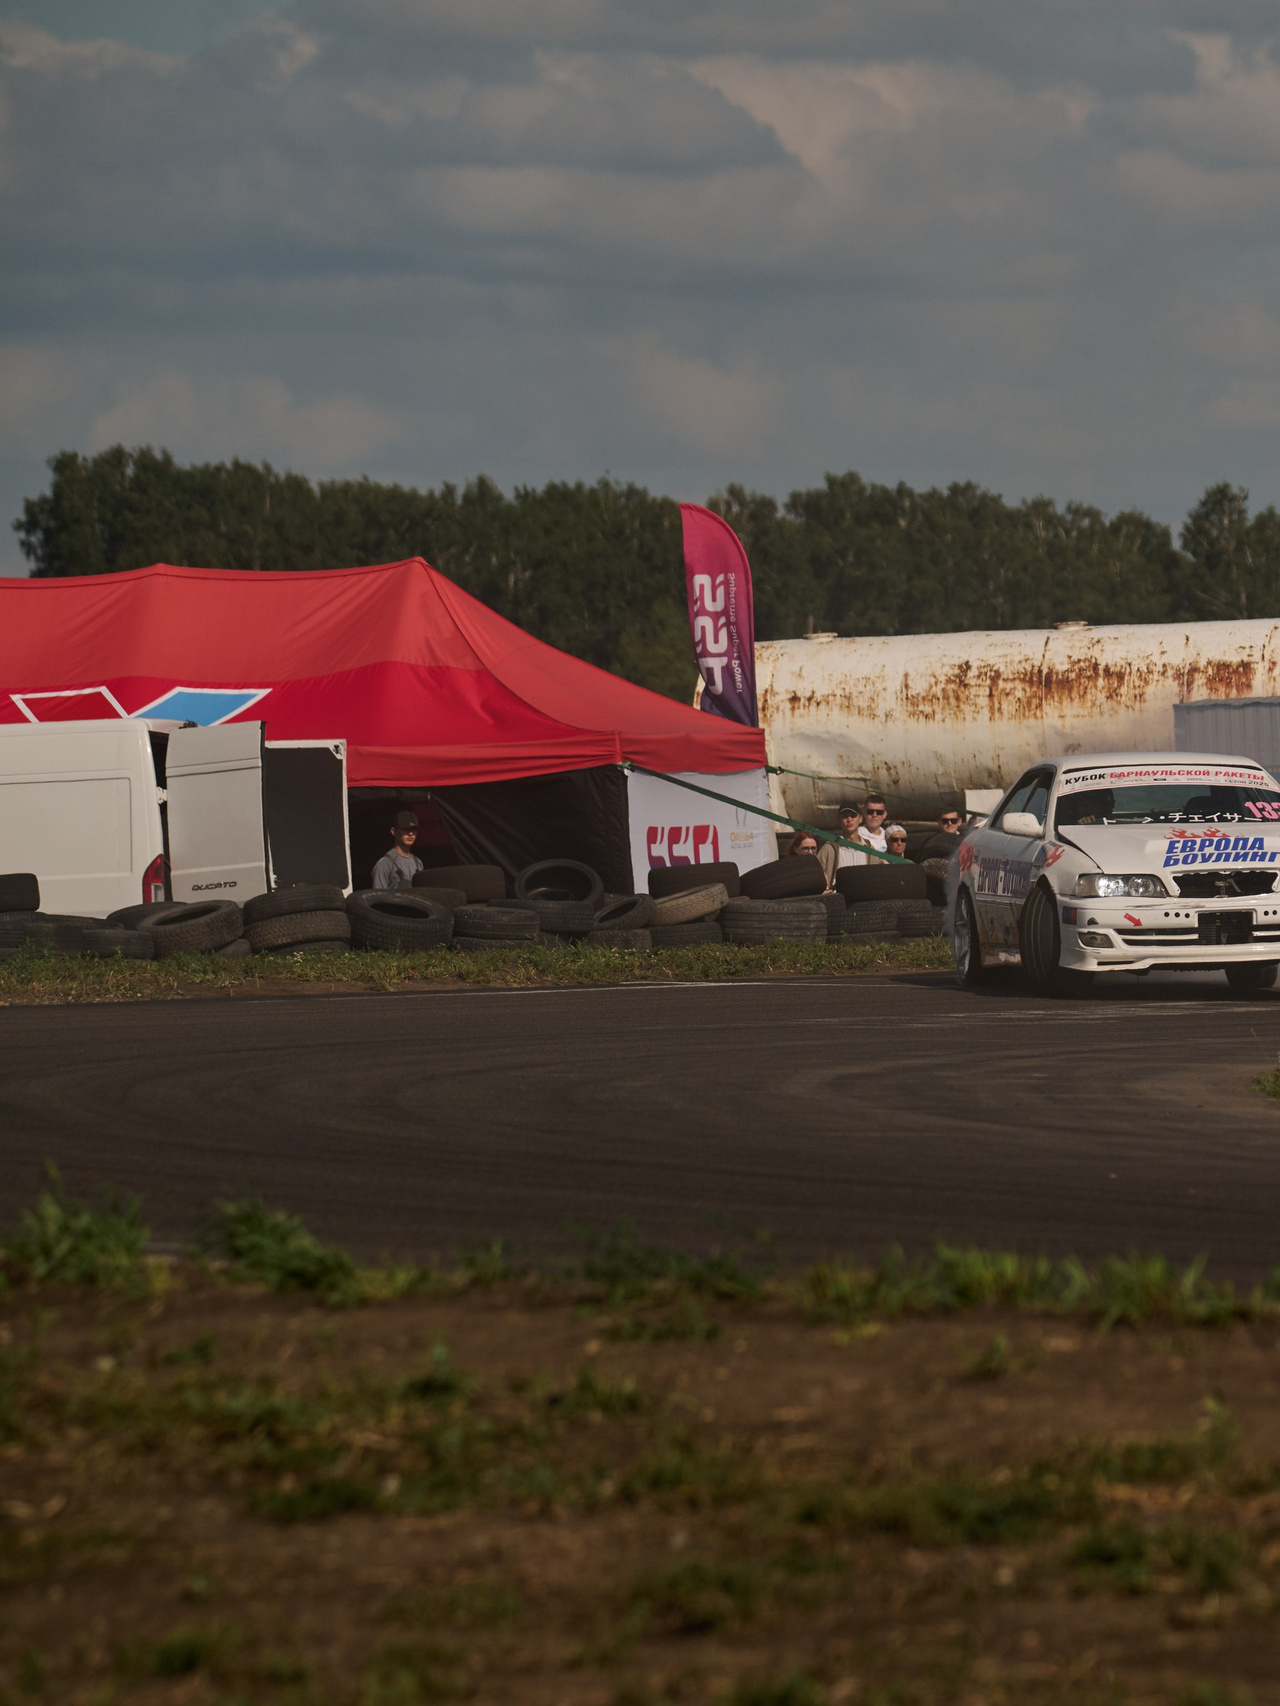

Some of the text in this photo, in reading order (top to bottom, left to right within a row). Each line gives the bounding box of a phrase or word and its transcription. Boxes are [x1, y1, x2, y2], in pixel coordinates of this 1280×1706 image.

[1065, 772, 1107, 786] КУБОК
[1109, 768, 1210, 779] БАРНАУЛЬСКОЙ
[1214, 770, 1265, 781] РАКЕТЫ
[1165, 837, 1265, 855] ЕВРОПА
[191, 880, 238, 892] DUCATO
